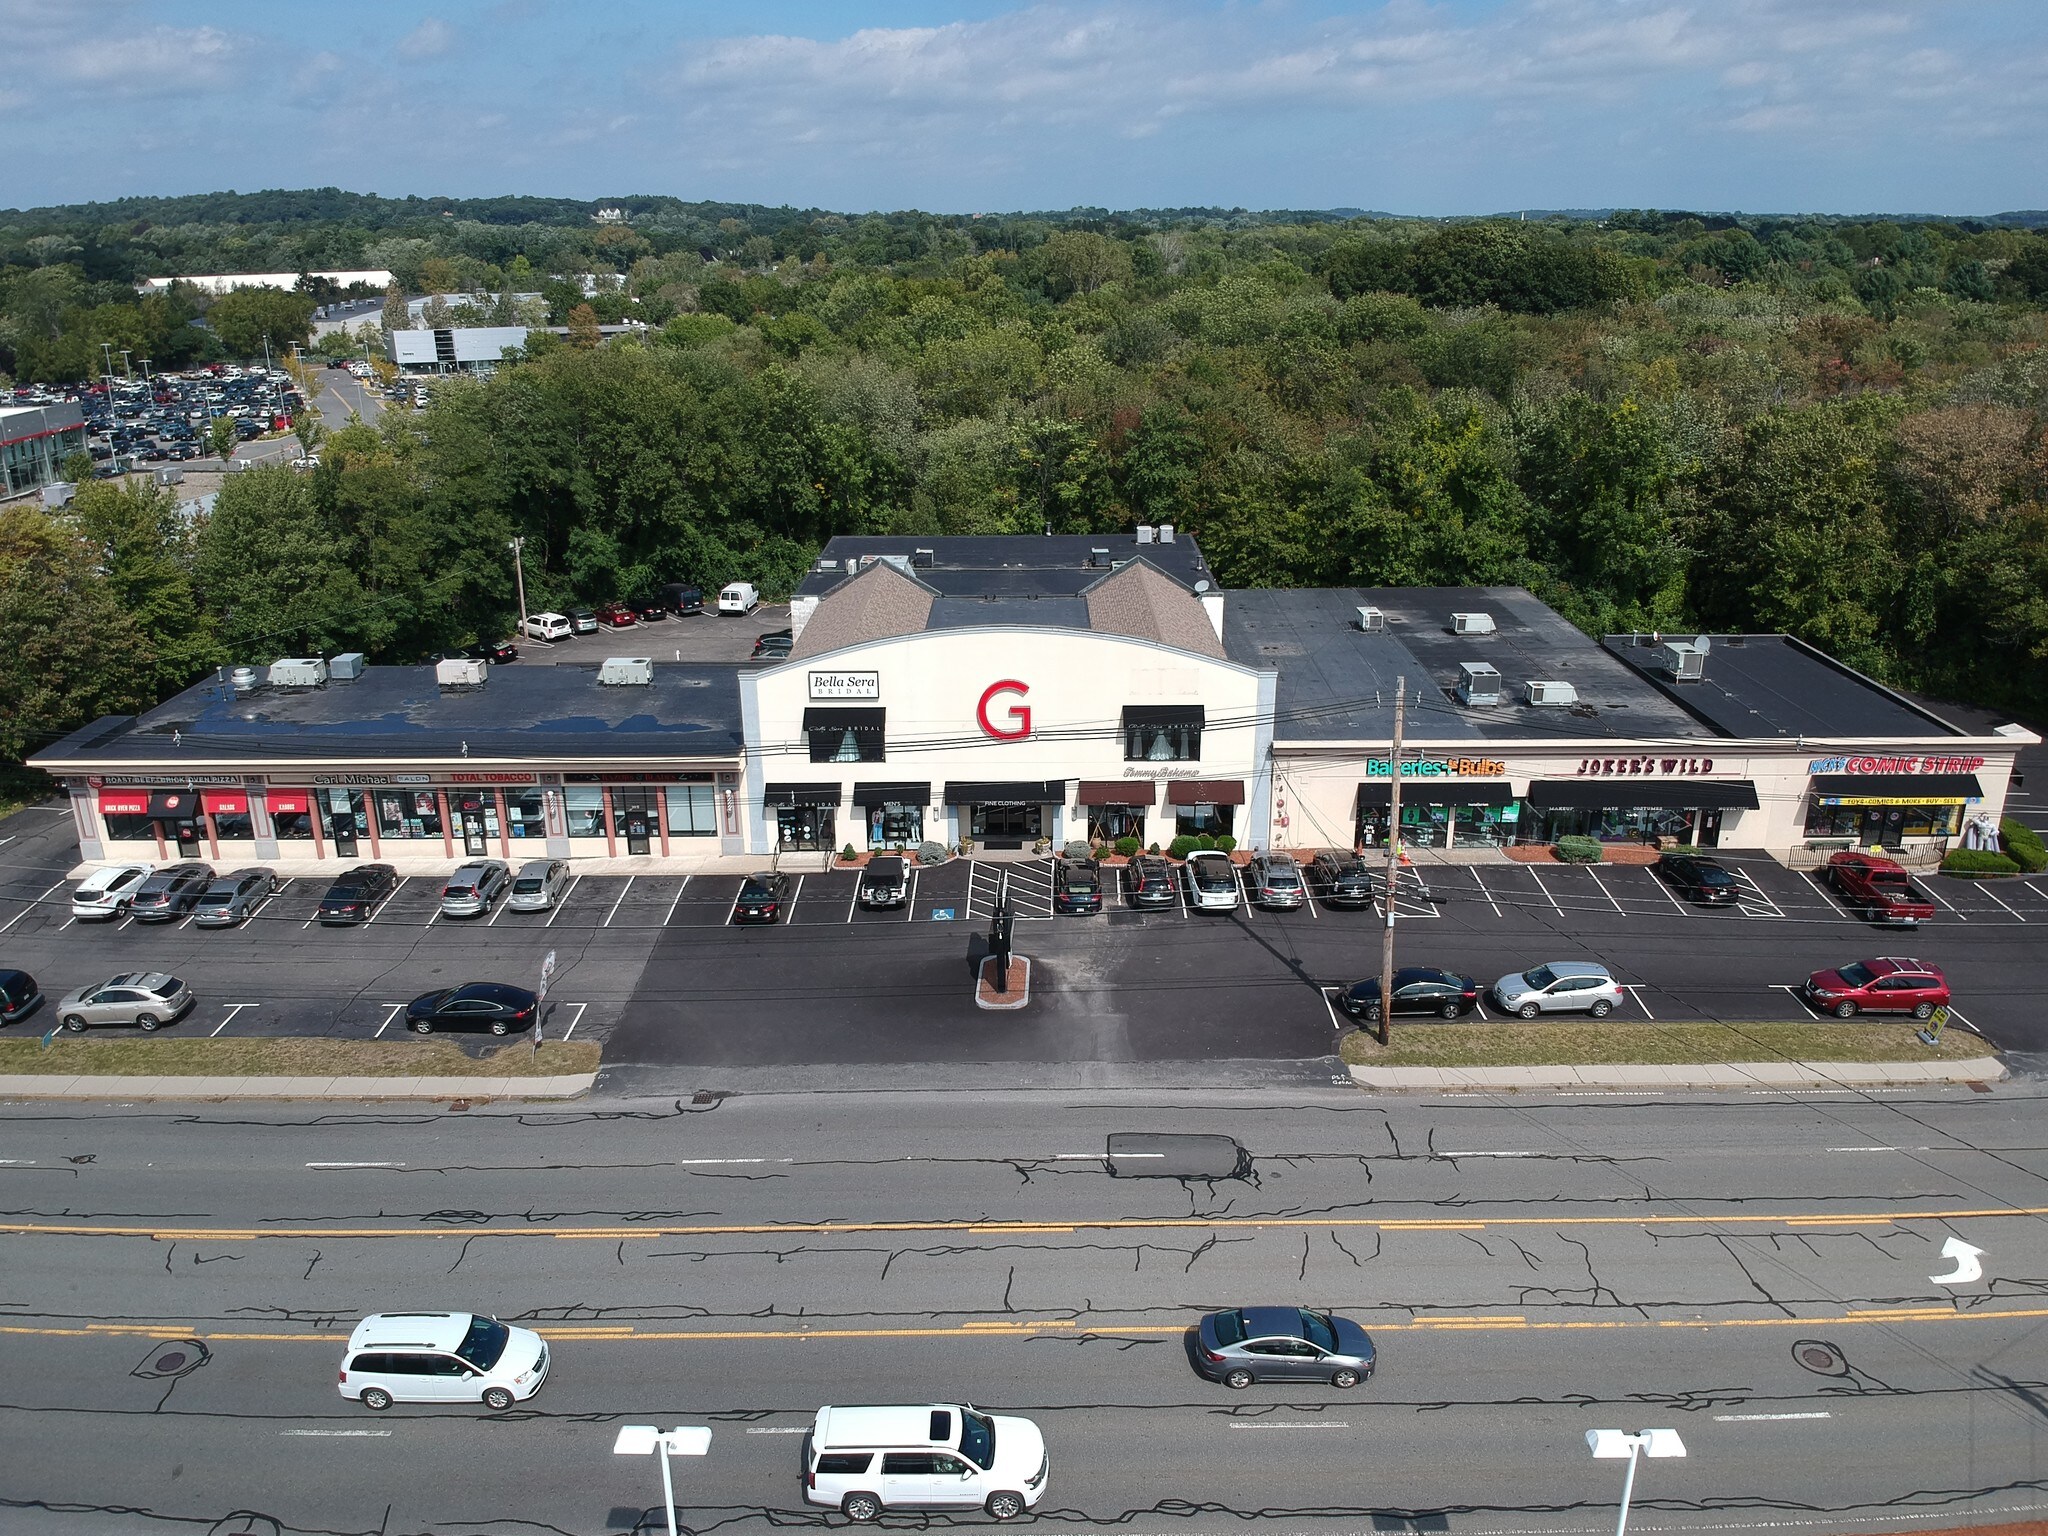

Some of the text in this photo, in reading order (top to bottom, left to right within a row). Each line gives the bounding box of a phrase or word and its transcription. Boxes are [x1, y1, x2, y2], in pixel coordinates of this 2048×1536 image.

[814, 676, 875, 687] Bella Sera
[977, 679, 1031, 741] G
[1459, 758, 1505, 775] Bulbs
[1577, 756, 1713, 774] JOKER'S WILD
[1846, 757, 1918, 774] COMIC
[1922, 756, 1985, 773] STRIP
[313, 774, 339, 784] Carl
[344, 774, 391, 784] Michael
[450, 773, 532, 781] TOTAL TOBACCO
[1123, 767, 1200, 780] Tommy Bahama
